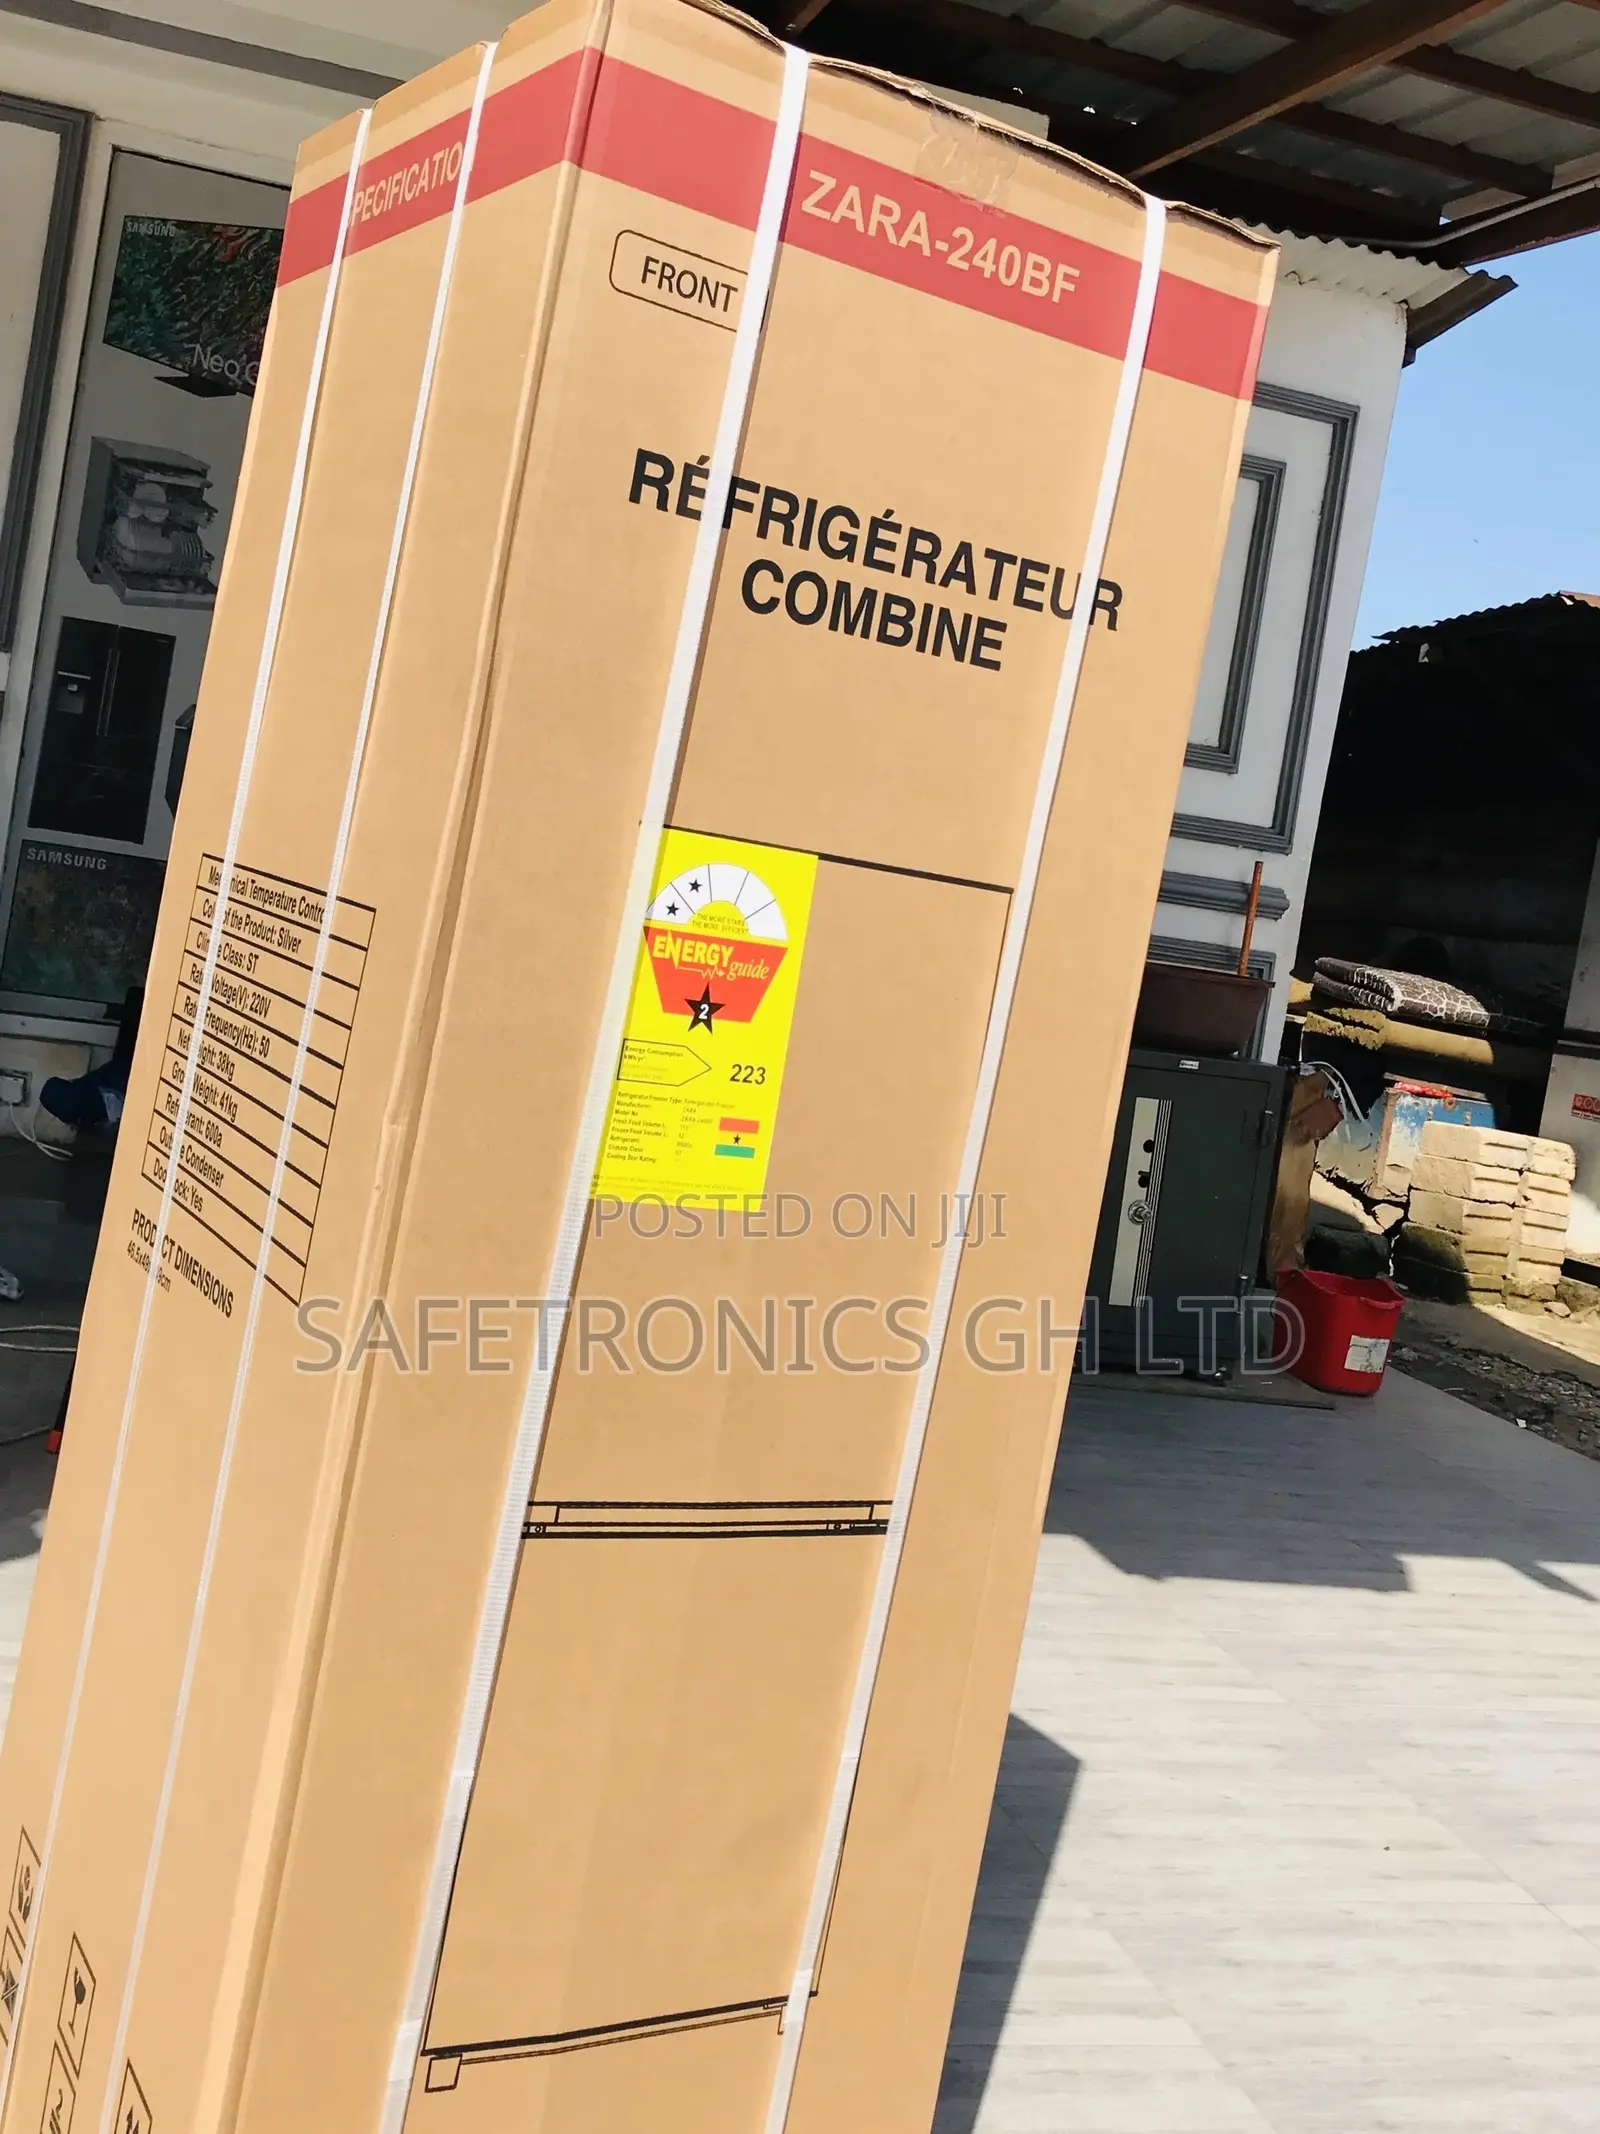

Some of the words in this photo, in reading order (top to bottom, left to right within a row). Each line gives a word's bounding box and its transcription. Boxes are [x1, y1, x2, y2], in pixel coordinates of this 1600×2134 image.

[350, 141, 473, 228] PECIFICATIO
[126, 221, 177, 238] SAMSUNG
[802, 169, 1081, 304] ZARA-240BF
[640, 255, 739, 313] FRONT
[628, 447, 1124, 632] RÉFRIGÉRATEUR
[741, 558, 1008, 671] COMBINE
[27, 847, 107, 870] SAMSUNG
[209, 866, 249, 897] Mecnical
[249, 879, 298, 917] Temperature
[298, 897, 326, 924] Contro
[231, 909, 244, 930] the
[244, 914, 278, 944] Product:
[277, 926, 303, 954] Silver
[652, 929, 735, 970] ENERGY
[726, 957, 770, 982] guide
[223, 941, 247, 969] Class:
[247, 952, 259, 974] ST
[250, 991, 272, 1019] 220V
[698, 1003, 710, 1020] 2
[178, 1028, 191, 1050] Net
[216, 1050, 236, 1081] 38kg
[204, 1006, 260, 1056] Frequency(Hz):
[259, 1035, 271, 1058] 50
[192, 1073, 220, 1109] Weight:
[219, 1090, 239, 1121] 41kg
[729, 1063, 767, 1086] 223
[205, 1119, 224, 1148] 600a
[186, 1144, 225, 1189] Condenser
[190, 1188, 204, 1213] Yes
[132, 1207, 175, 1264] PRODCT
[175, 1245, 235, 1319] DIMENSIONS
